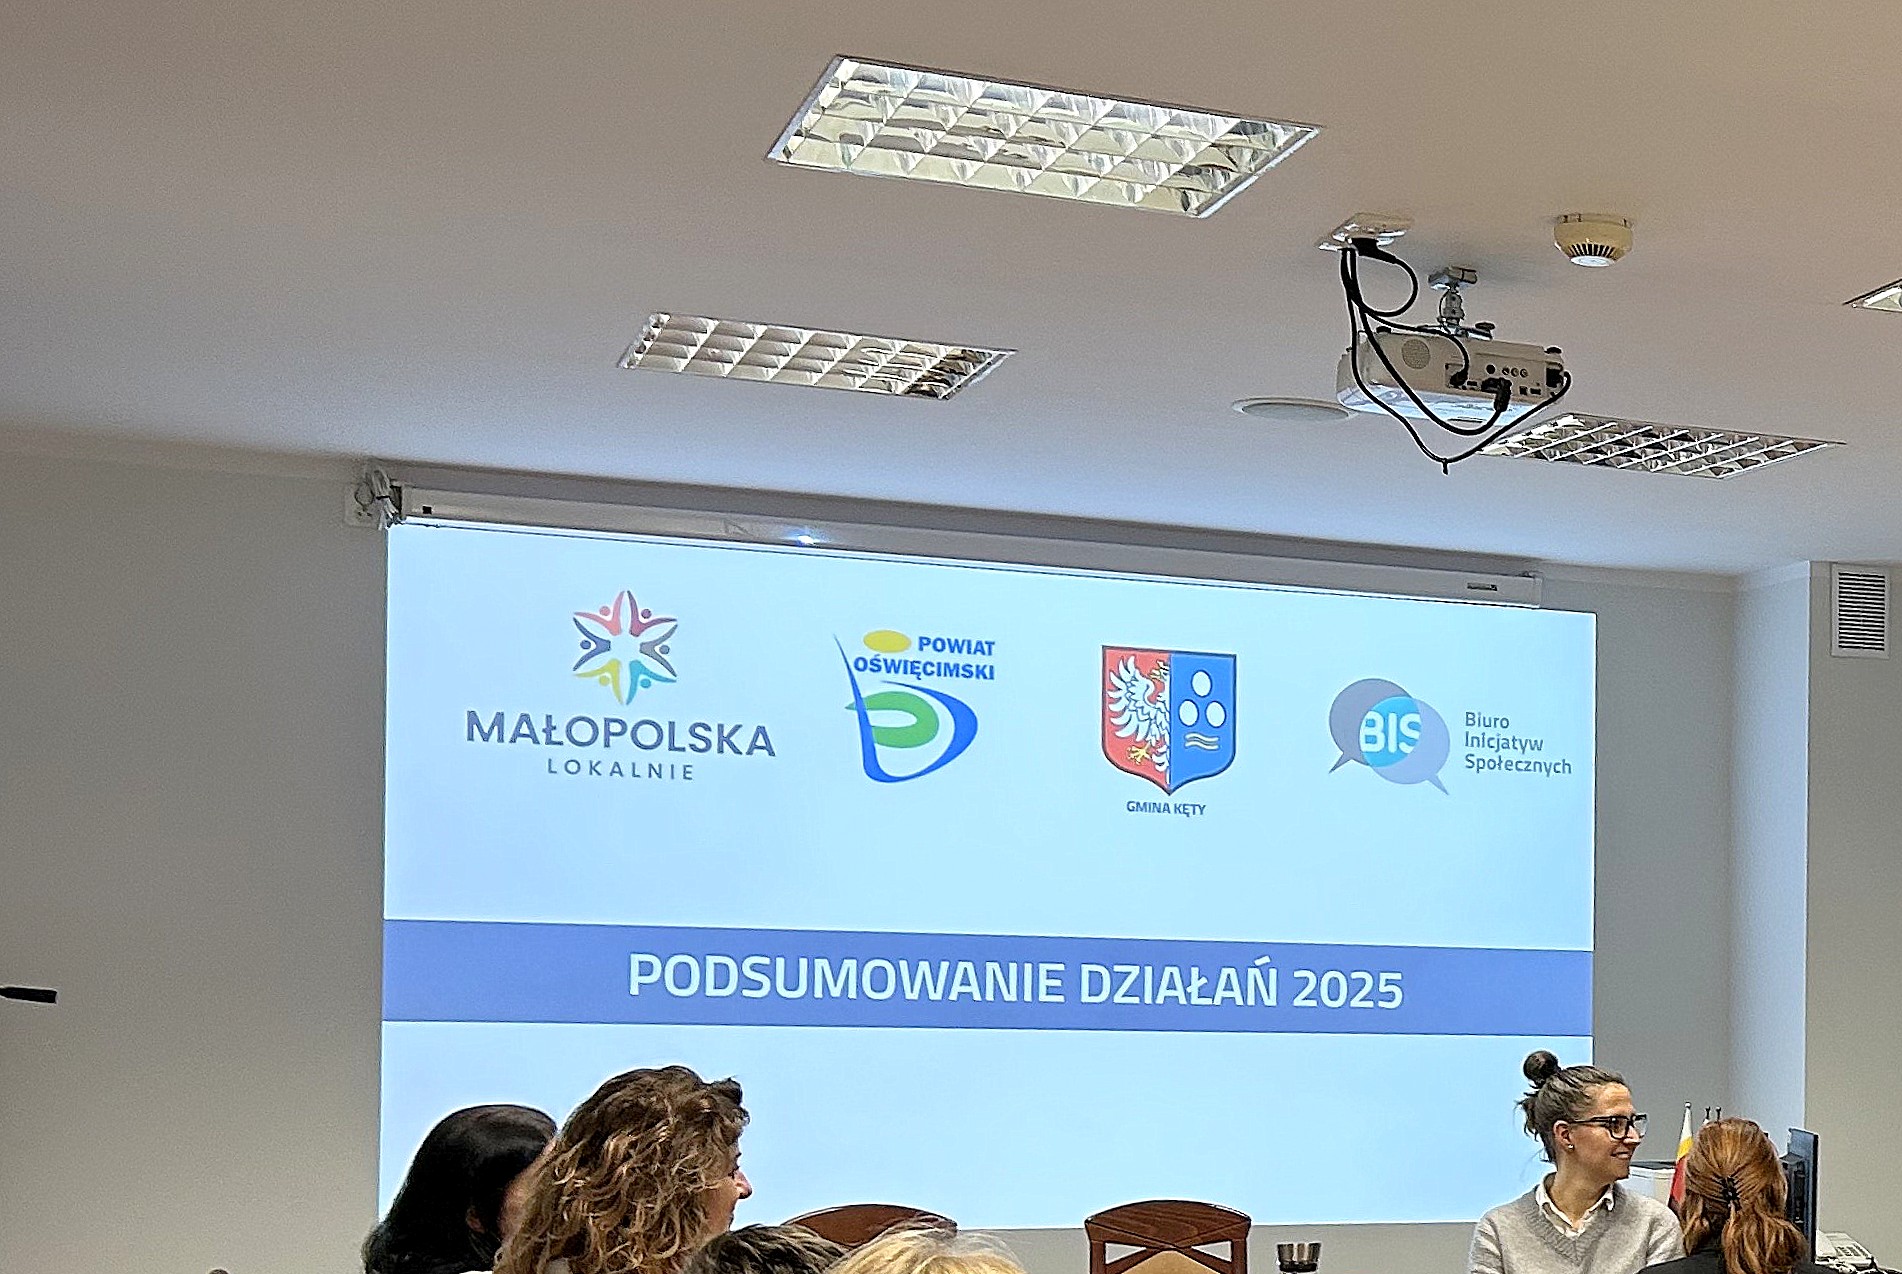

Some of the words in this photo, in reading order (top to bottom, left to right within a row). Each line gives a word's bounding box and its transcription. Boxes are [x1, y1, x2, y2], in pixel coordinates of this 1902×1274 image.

[918, 636, 995, 656] POWIAT
[854, 654, 995, 681] OŚWIĘCIMSKI
[1465, 711, 1510, 729] Biuro
[466, 710, 776, 757] MAŁOPOLSKA
[1360, 711, 1422, 754] BIS
[1465, 731, 1544, 754] Inicjatyw
[547, 758, 694, 781] LOKALNIE
[1465, 753, 1572, 777] Społecznych
[1126, 801, 1171, 814] GMINA
[1174, 803, 1206, 818] KĘTY
[629, 953, 1065, 1003] PODSUMOWANIE
[1080, 955, 1278, 1007] DZIAŁAŃ
[1292, 970, 1403, 1009] 2025
